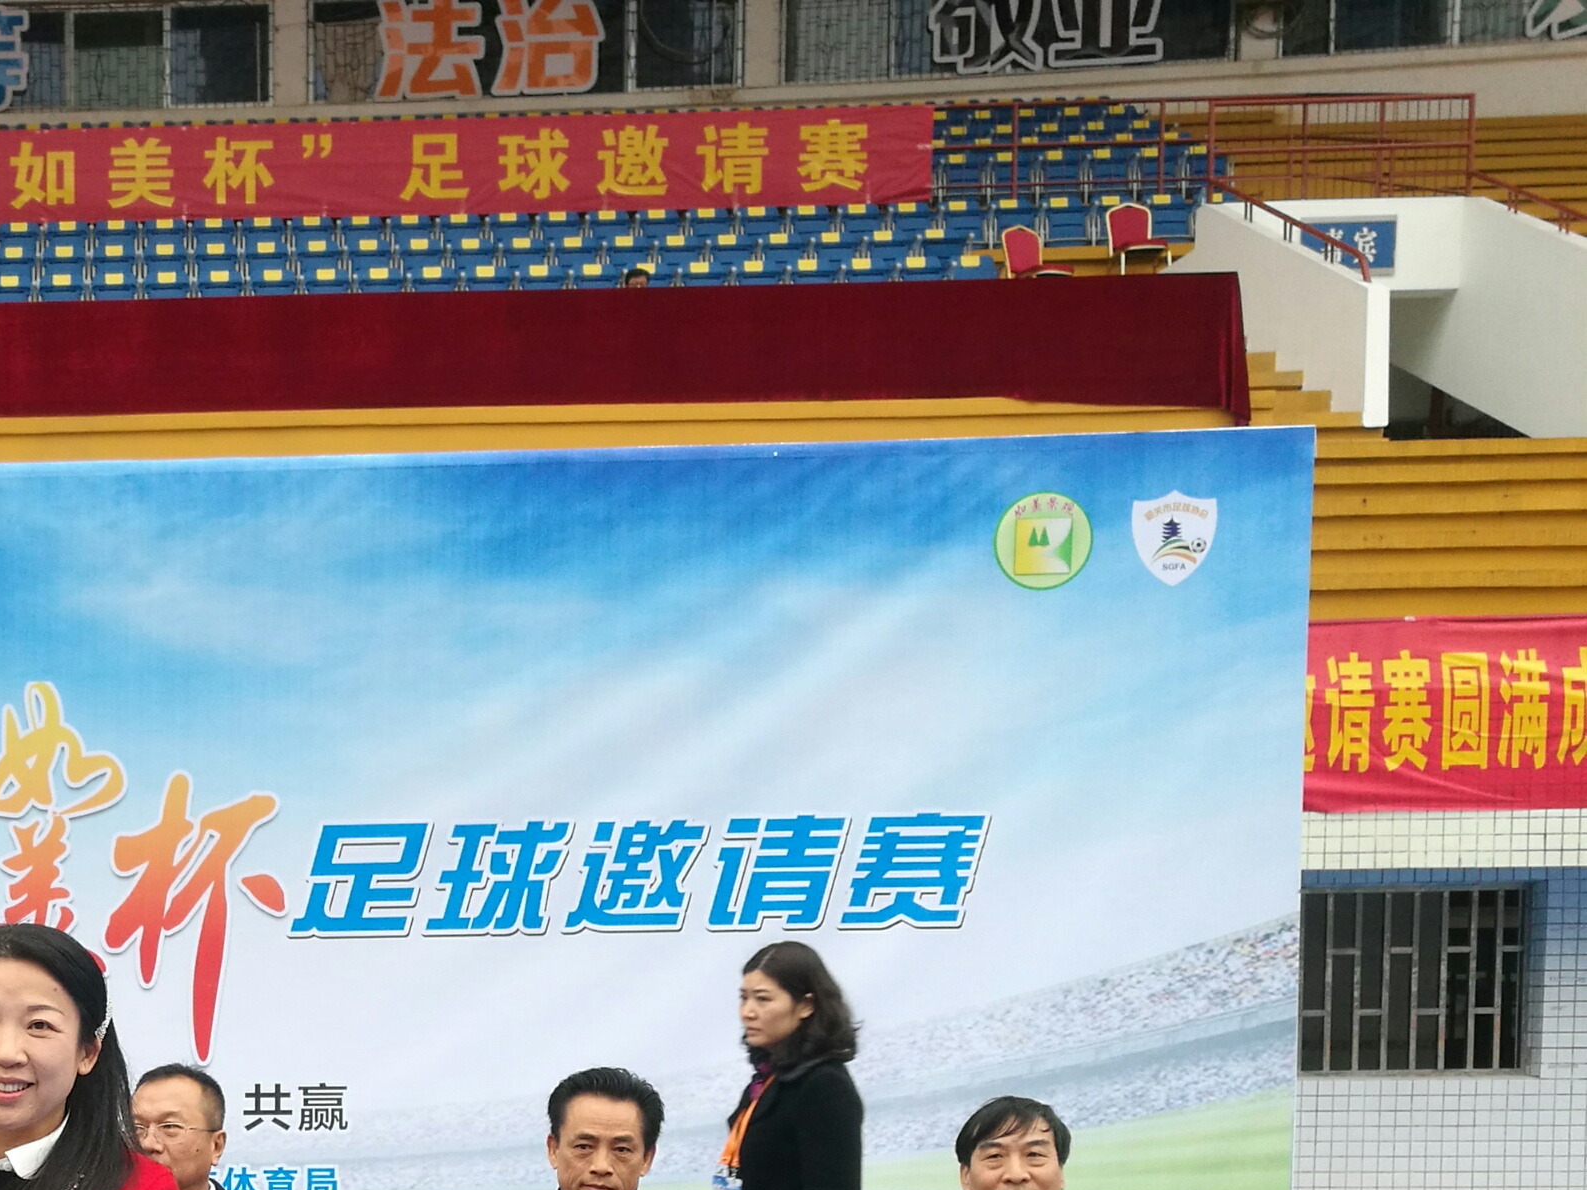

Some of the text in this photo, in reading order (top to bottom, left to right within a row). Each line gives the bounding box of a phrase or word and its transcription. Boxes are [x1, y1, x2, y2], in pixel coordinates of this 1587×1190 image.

[375, 0, 605, 100] 法治
[1303, 646, 1587, 773] 请赛圆满成
[289, 812, 990, 938] 足球邀请赛
[243, 1083, 348, 1131] 共赢
